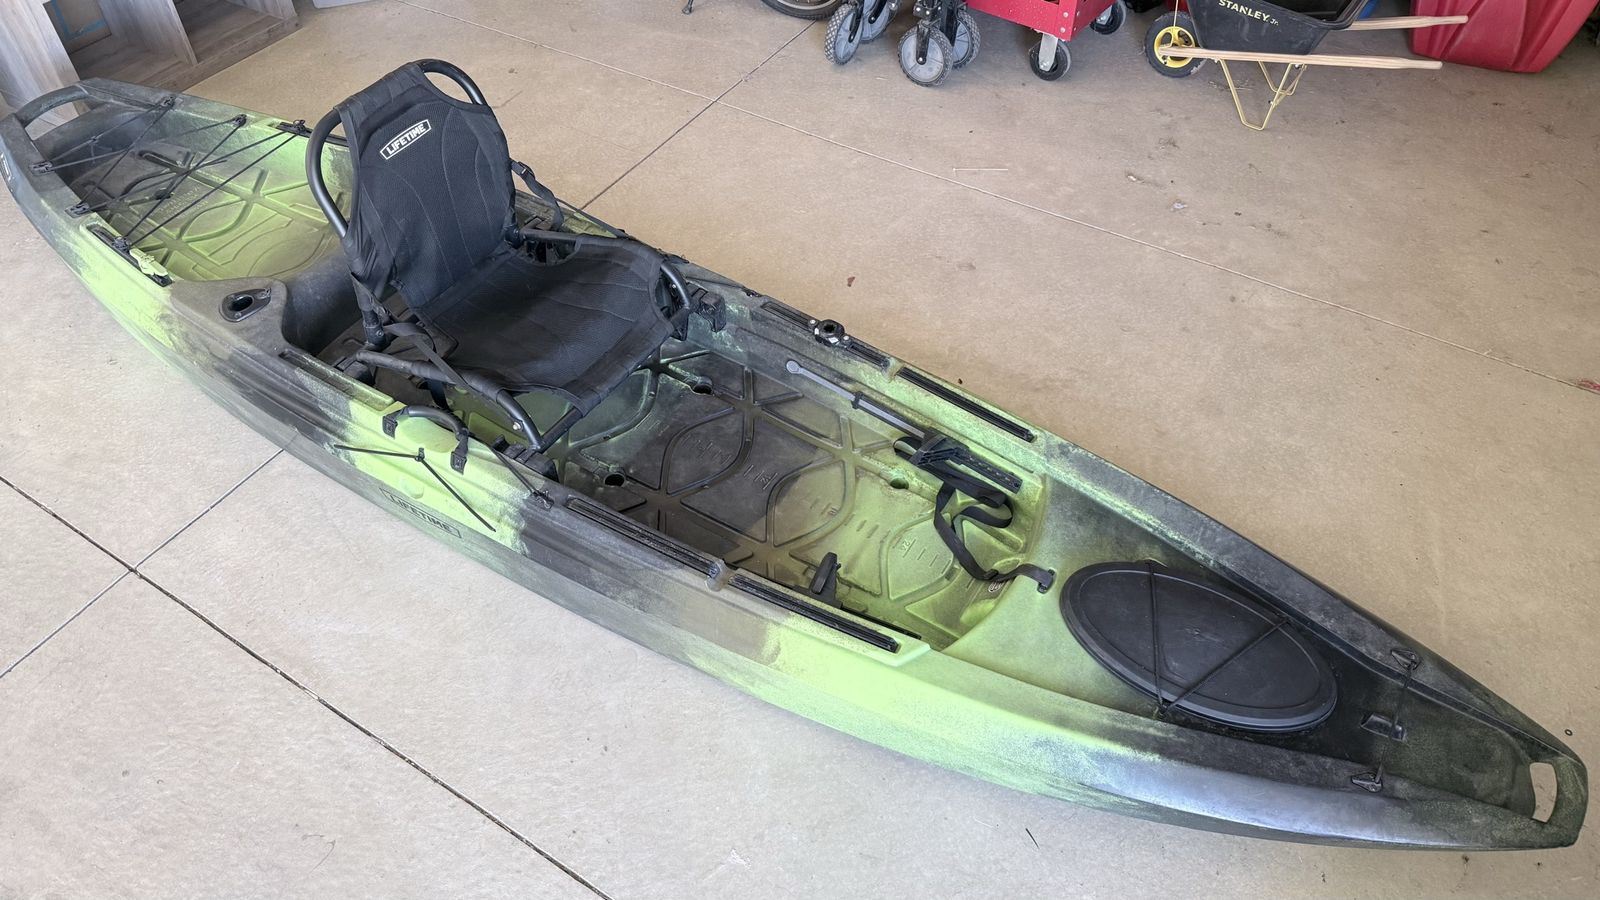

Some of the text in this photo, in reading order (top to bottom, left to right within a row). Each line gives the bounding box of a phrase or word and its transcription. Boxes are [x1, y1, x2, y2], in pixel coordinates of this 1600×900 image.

[1218, 0, 1270, 22] STANLEY
[386, 123, 426, 155] LIFETIME
[389, 494, 454, 534] LIFETIME
